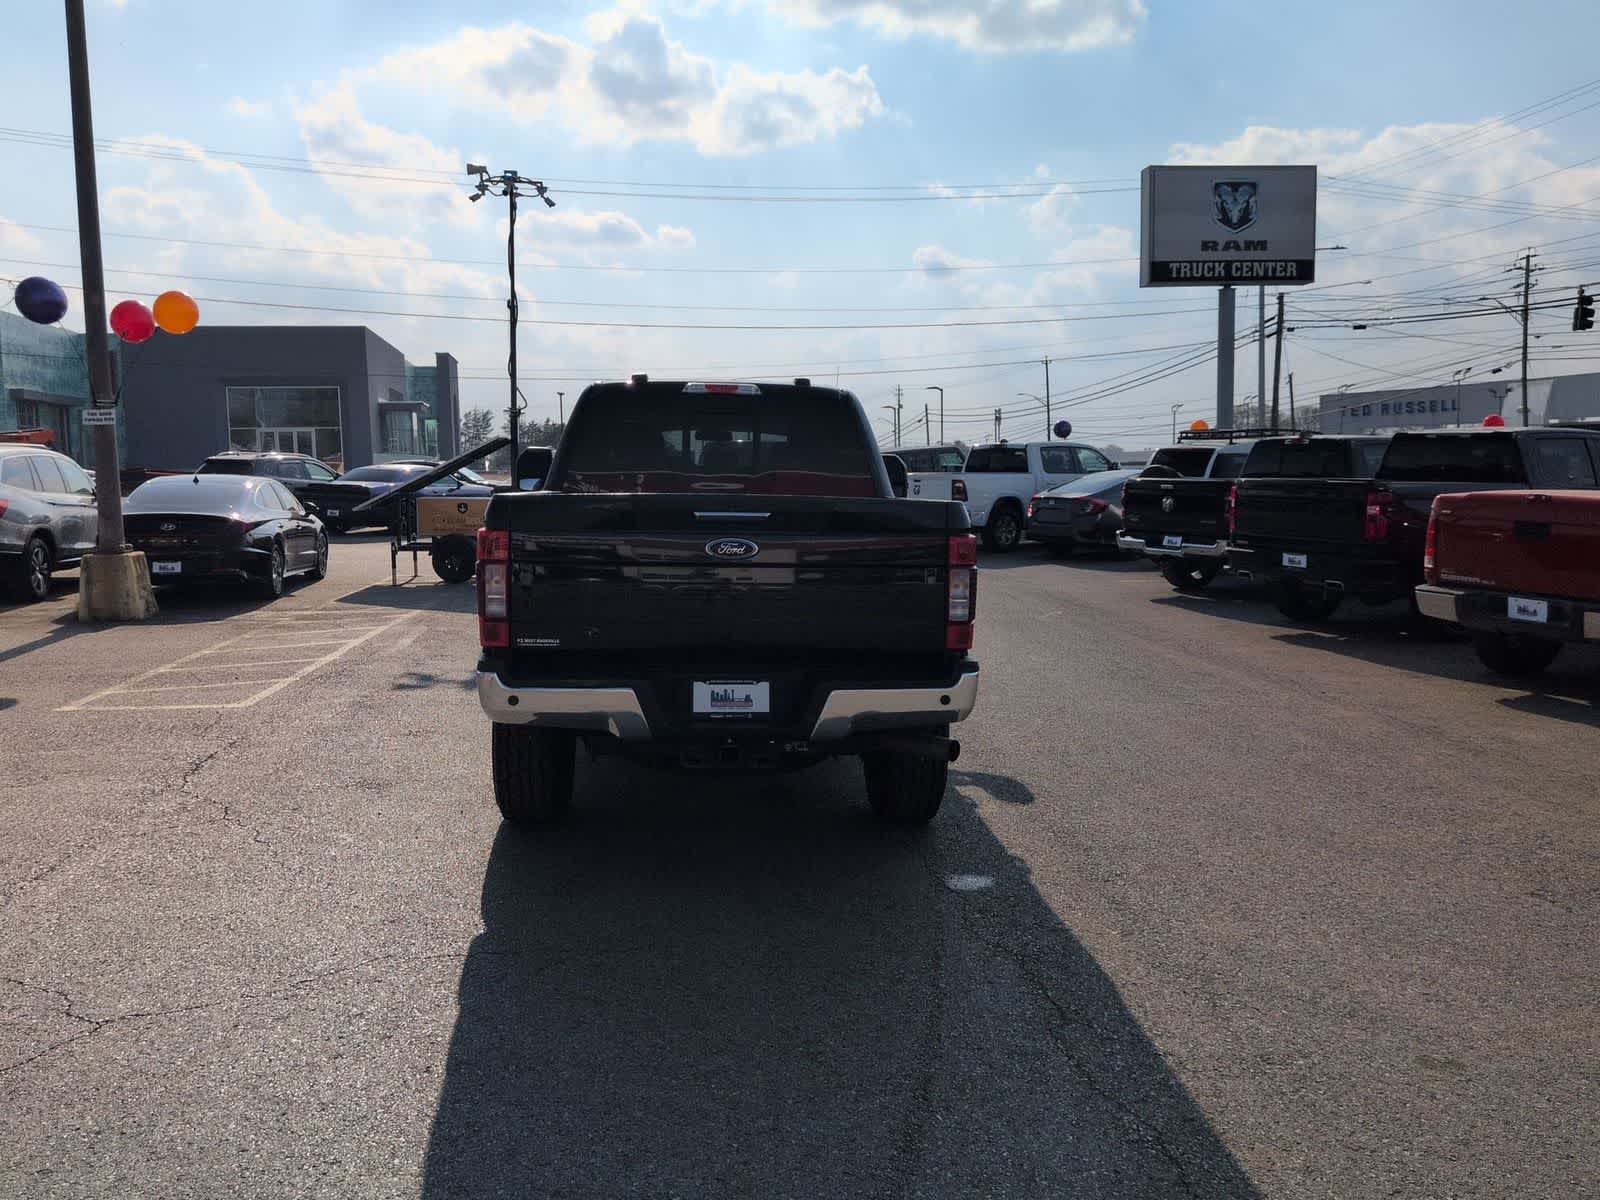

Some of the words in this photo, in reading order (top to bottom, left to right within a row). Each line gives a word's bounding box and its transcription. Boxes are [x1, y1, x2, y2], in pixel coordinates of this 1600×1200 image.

[1201, 240, 1268, 251] RAM
[1169, 262, 1225, 278] TRUCK
[1231, 262, 1297, 277] CENTER
[1380, 400, 1457, 415] RUSSELL
[717, 542, 746, 554] Ford
